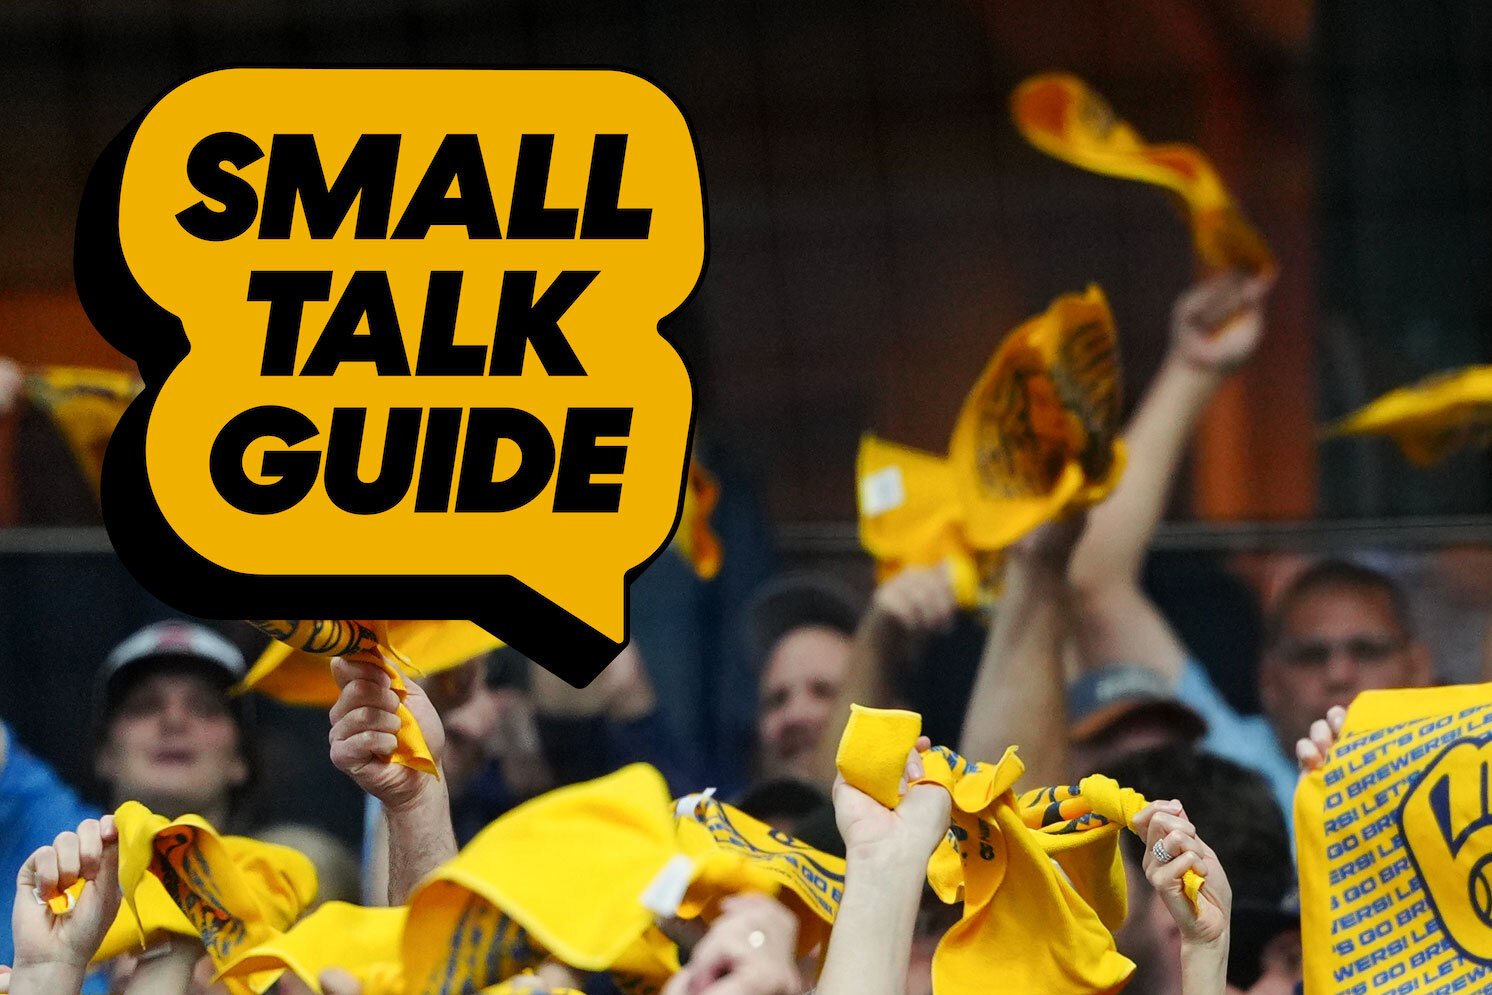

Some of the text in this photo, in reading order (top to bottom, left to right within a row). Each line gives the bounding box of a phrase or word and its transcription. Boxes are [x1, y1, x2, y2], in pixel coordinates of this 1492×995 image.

[1419, 715, 1453, 737] GO
[1346, 727, 1462, 798] BREWERS!
[1327, 834, 1359, 859] GO
[1343, 876, 1377, 903] GO
[1358, 919, 1393, 946] GO
[1372, 962, 1406, 988] GO
